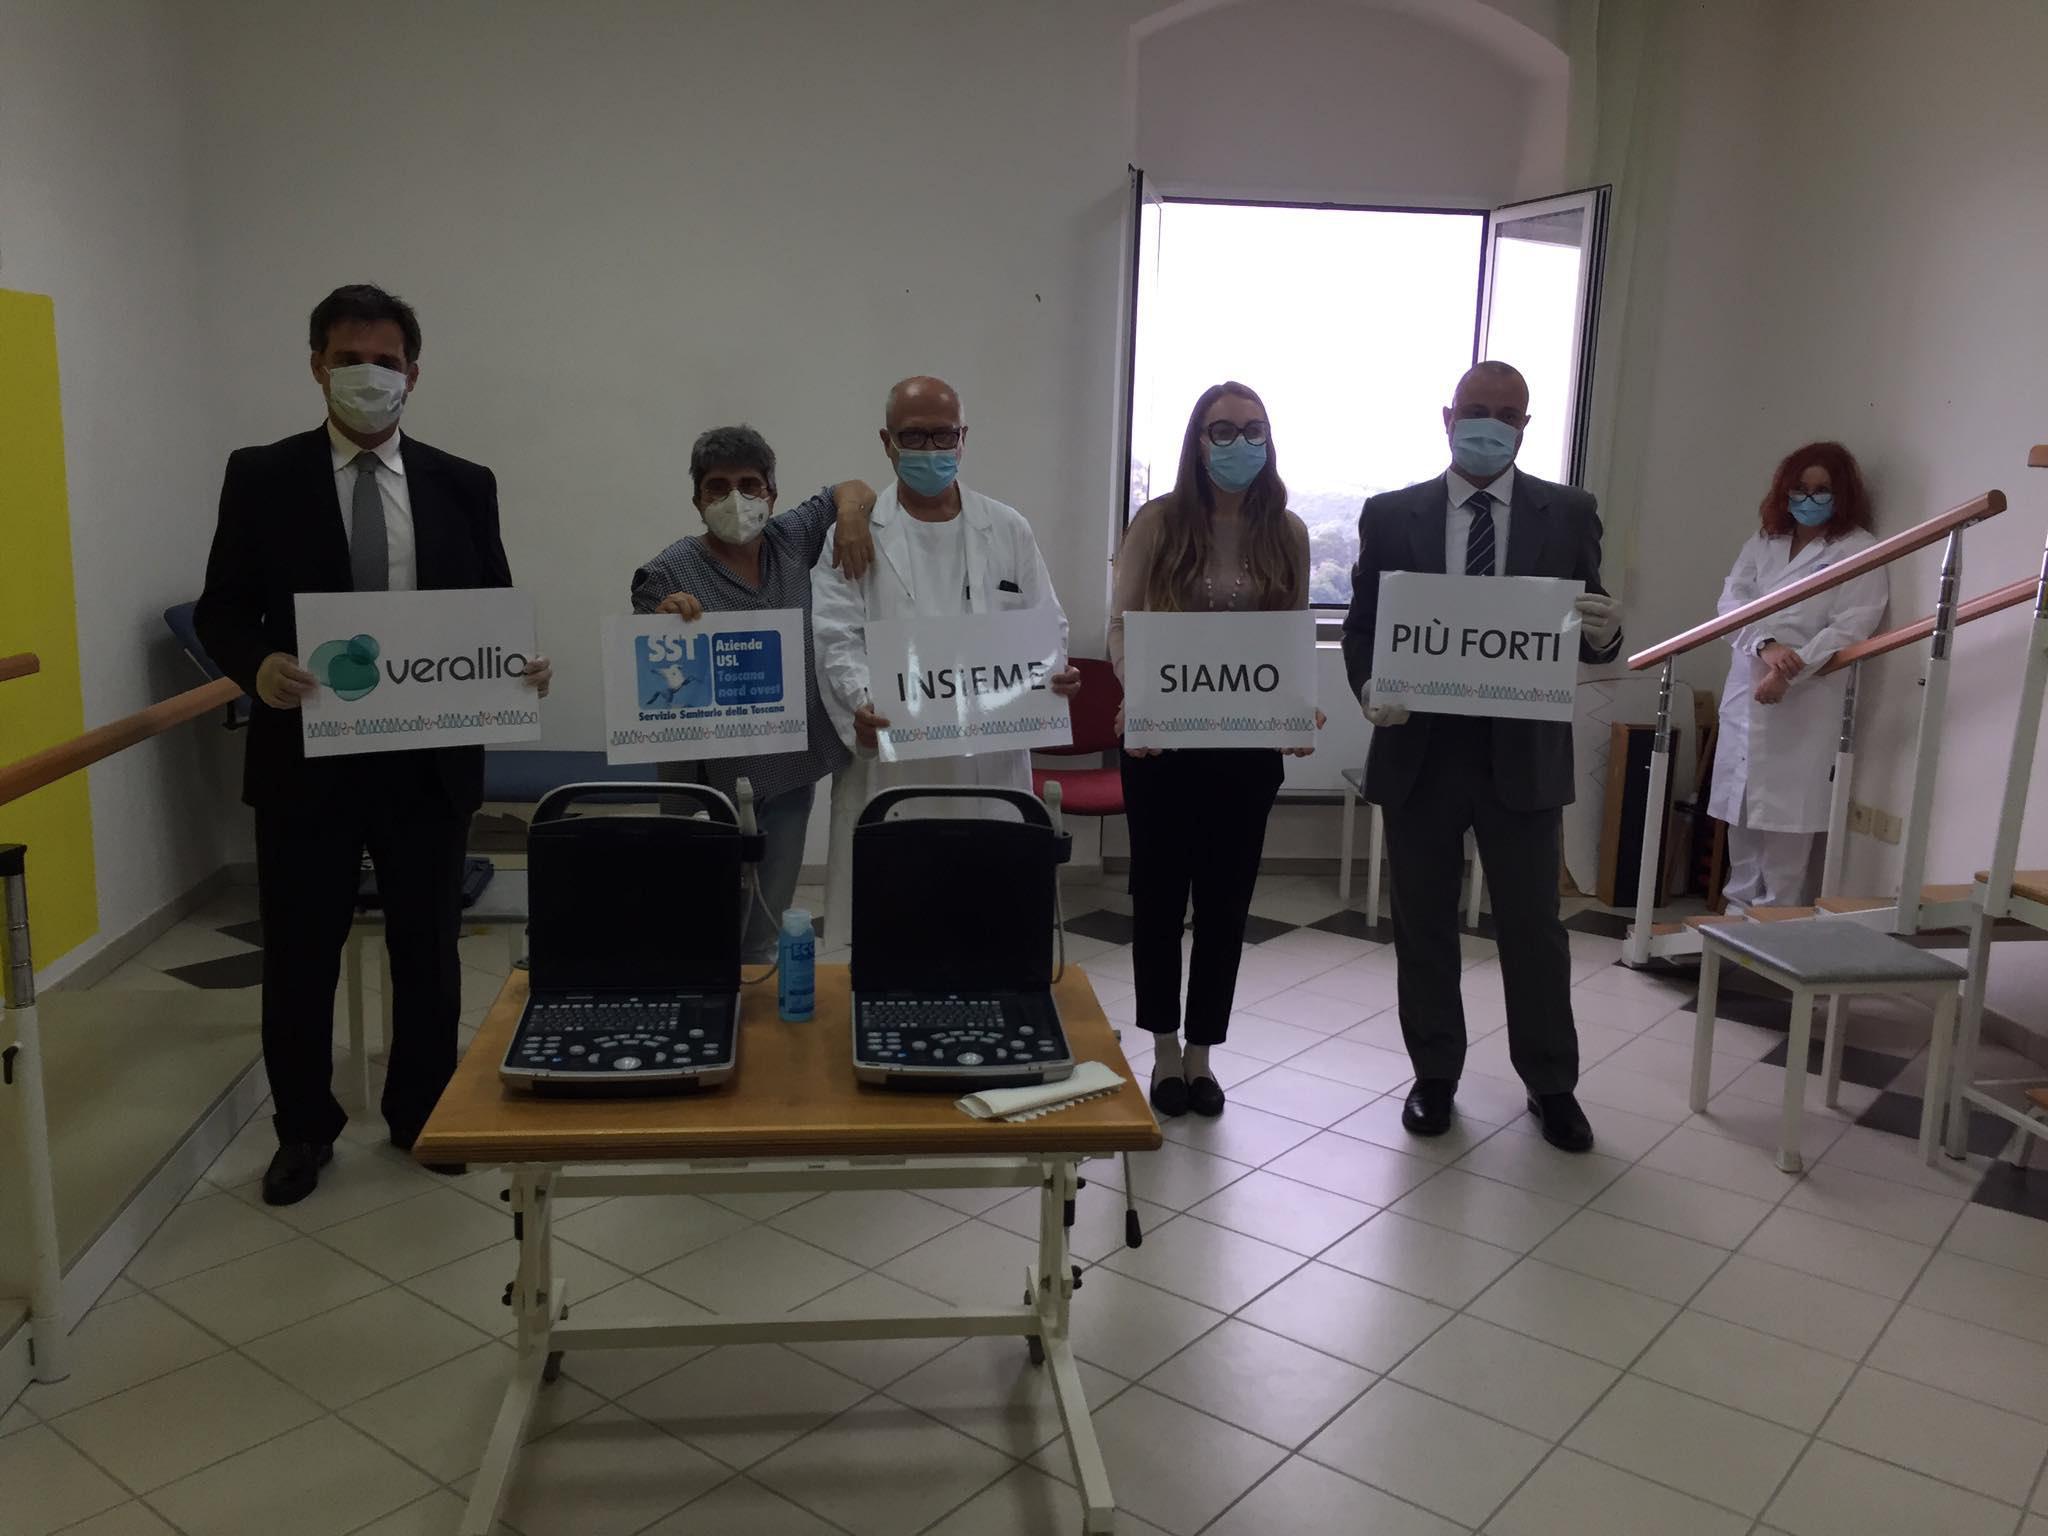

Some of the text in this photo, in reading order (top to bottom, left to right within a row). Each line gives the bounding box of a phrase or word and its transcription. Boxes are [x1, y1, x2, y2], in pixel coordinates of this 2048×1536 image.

[647, 632, 700, 663] SST
[715, 638, 763, 652] Azienda
[1391, 617, 1561, 662] PIÙ FORTI
[385, 646, 529, 685] verallia
[716, 654, 740, 667] USL
[717, 670, 766, 682] Toscana
[897, 661, 1046, 702] INSIEME
[1159, 663, 1280, 693] SIAMO
[718, 684, 781, 698] nord ovest
[638, 704, 785, 721] Servizio Sanitario della Toscana
